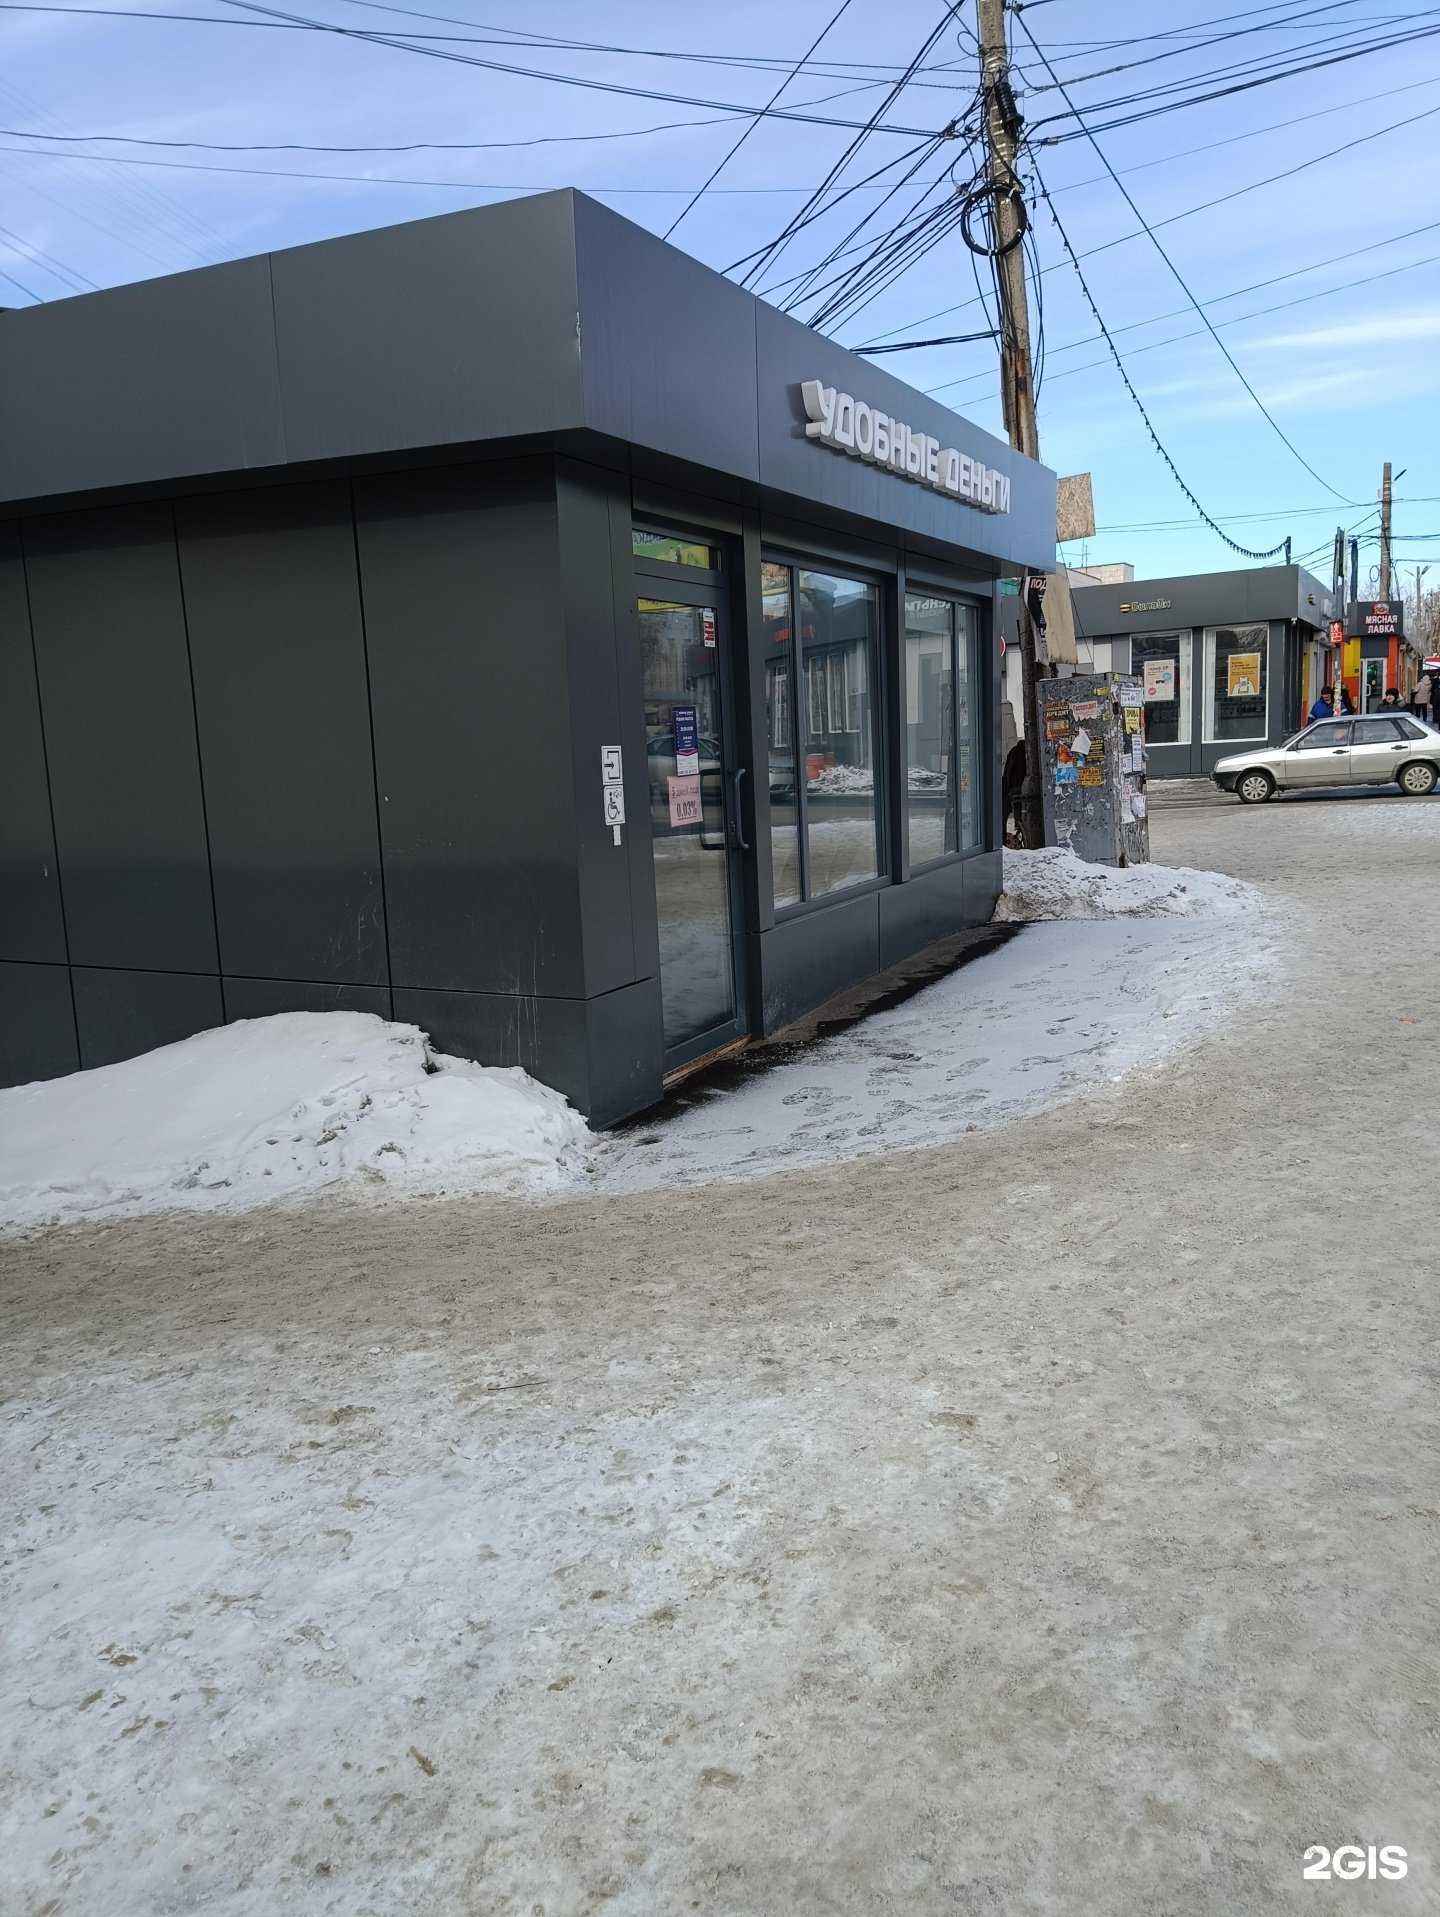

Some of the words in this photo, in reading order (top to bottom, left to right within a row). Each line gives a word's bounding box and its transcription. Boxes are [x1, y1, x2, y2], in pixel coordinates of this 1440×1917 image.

[801, 380, 940, 483] УДОБНЫЕ
[939, 448, 1010, 514] ДЕНЬГИ
[1365, 614, 1398, 625] МЯСНАЯ
[1367, 624, 1395, 634] ЛАВКА
